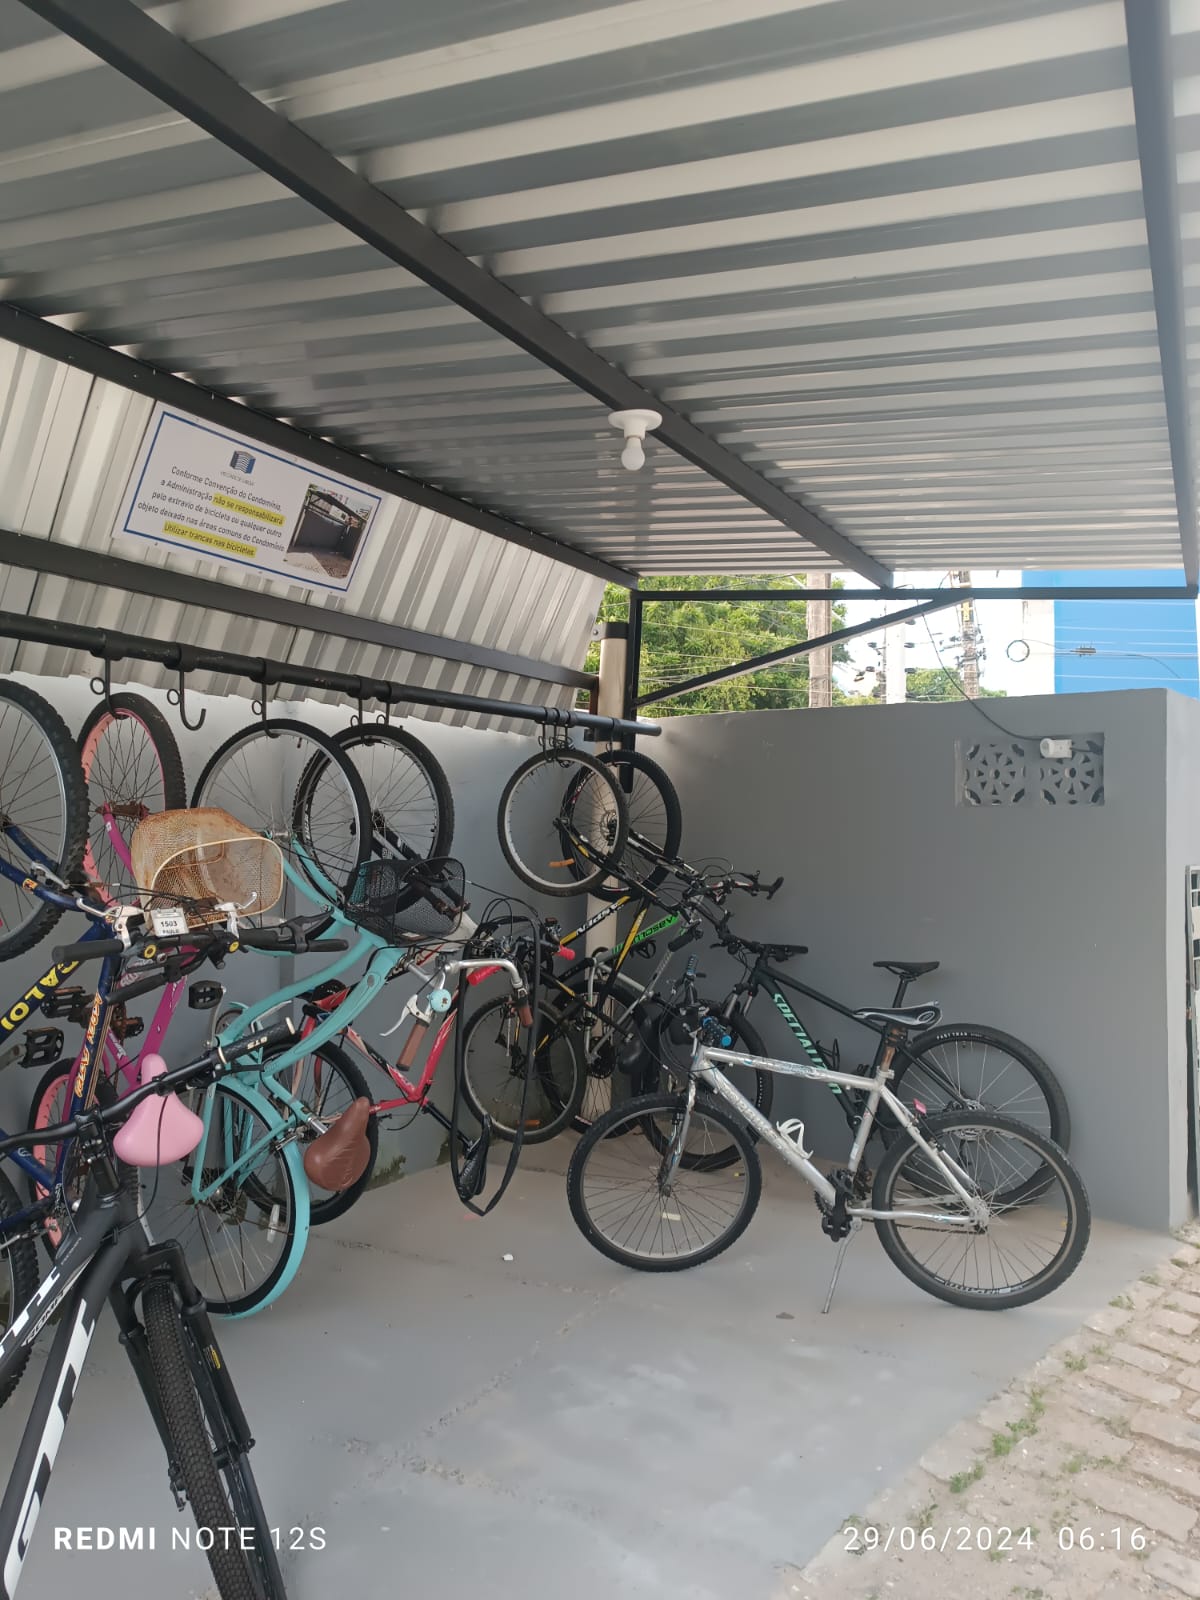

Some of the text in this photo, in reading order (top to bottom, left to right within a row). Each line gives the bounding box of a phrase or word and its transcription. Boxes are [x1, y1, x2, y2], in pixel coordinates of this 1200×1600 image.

[166, 480, 212, 501] Administração
[213, 496, 226, 505] não
[226, 501, 234, 509] se
[172, 466, 203, 483] Conforme
[204, 477, 238, 495] Convenção
[239, 490, 246, 498] do
[138, 501, 285, 552] objeto deixado nas áreas comuns do Condomínio
[152, 492, 167, 501] pelo
[168, 496, 194, 510] extravio
[194, 504, 203, 512] de
[204, 506, 230, 521] bicicleta
[240, 519, 266, 533] qualquer
[266, 527, 282, 538] outro
[164, 521, 188, 536] Utilizar
[189, 531, 212, 544] trancas
[213, 539, 225, 548] nas
